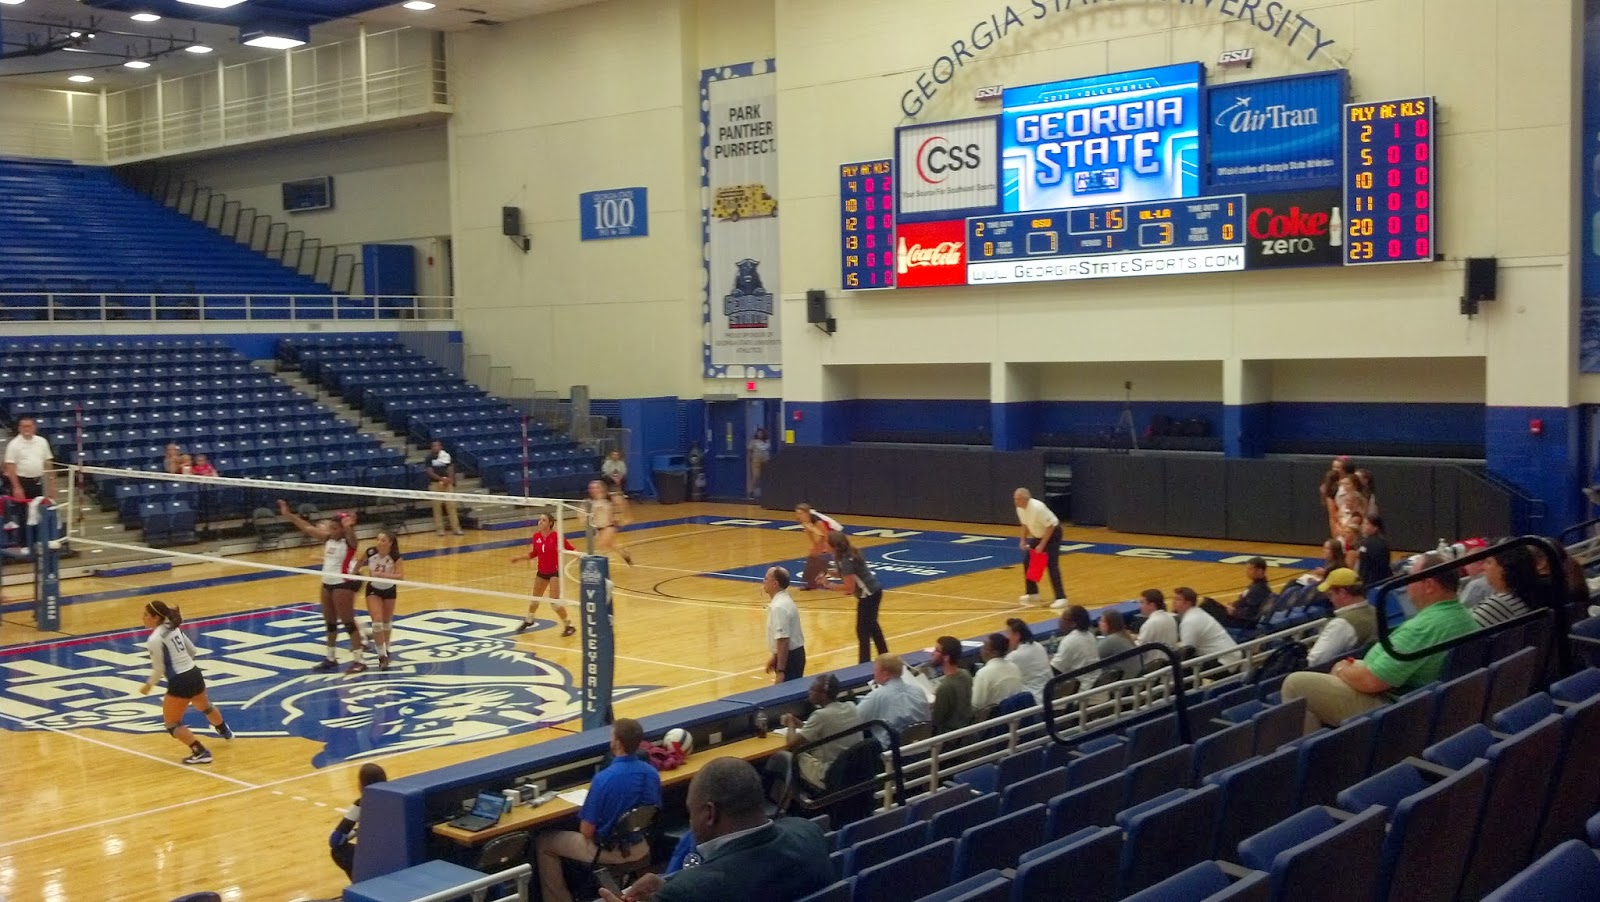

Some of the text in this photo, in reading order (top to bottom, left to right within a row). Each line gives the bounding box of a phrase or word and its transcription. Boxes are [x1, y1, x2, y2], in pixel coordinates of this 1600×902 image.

[901, 6, 1025, 119] GEORGIA
[1219, 49, 1254, 64] GSU
[1078, 82, 1152, 97] VOLLEYBALL
[729, 104, 761, 122] PARK
[1016, 97, 1183, 143] GEORGIA
[1230, 105, 1318, 133] airTran
[1351, 101, 1425, 122] PLY AC KLS
[719, 121, 773, 141] PANTHER
[1360, 118, 1428, 143] 2 1 0
[927, 144, 980, 174] CSS
[1036, 132, 1160, 185] STATE
[1360, 142, 1428, 166] 5 0 0
[1355, 166, 1428, 189] 10 0 0
[1227, 202, 1234, 217] 1
[1355, 190, 1428, 212] 11 0 0
[593, 198, 634, 230] 100
[1089, 209, 1123, 229] 1:15
[1248, 206, 1329, 240] Coke
[1350, 213, 1428, 236] 20 0 0
[975, 222, 985, 237] 2
[1159, 223, 1171, 244] 3
[1222, 223, 1234, 241] 0
[983, 241, 994, 257] 0
[1044, 232, 1056, 250] 7
[1106, 235, 1112, 248] 1
[1261, 237, 1313, 255] zero
[1350, 237, 1428, 259] 23 0 0
[171, 635, 185, 653] 15
[586, 589, 598, 713] VOLLEYBALL
